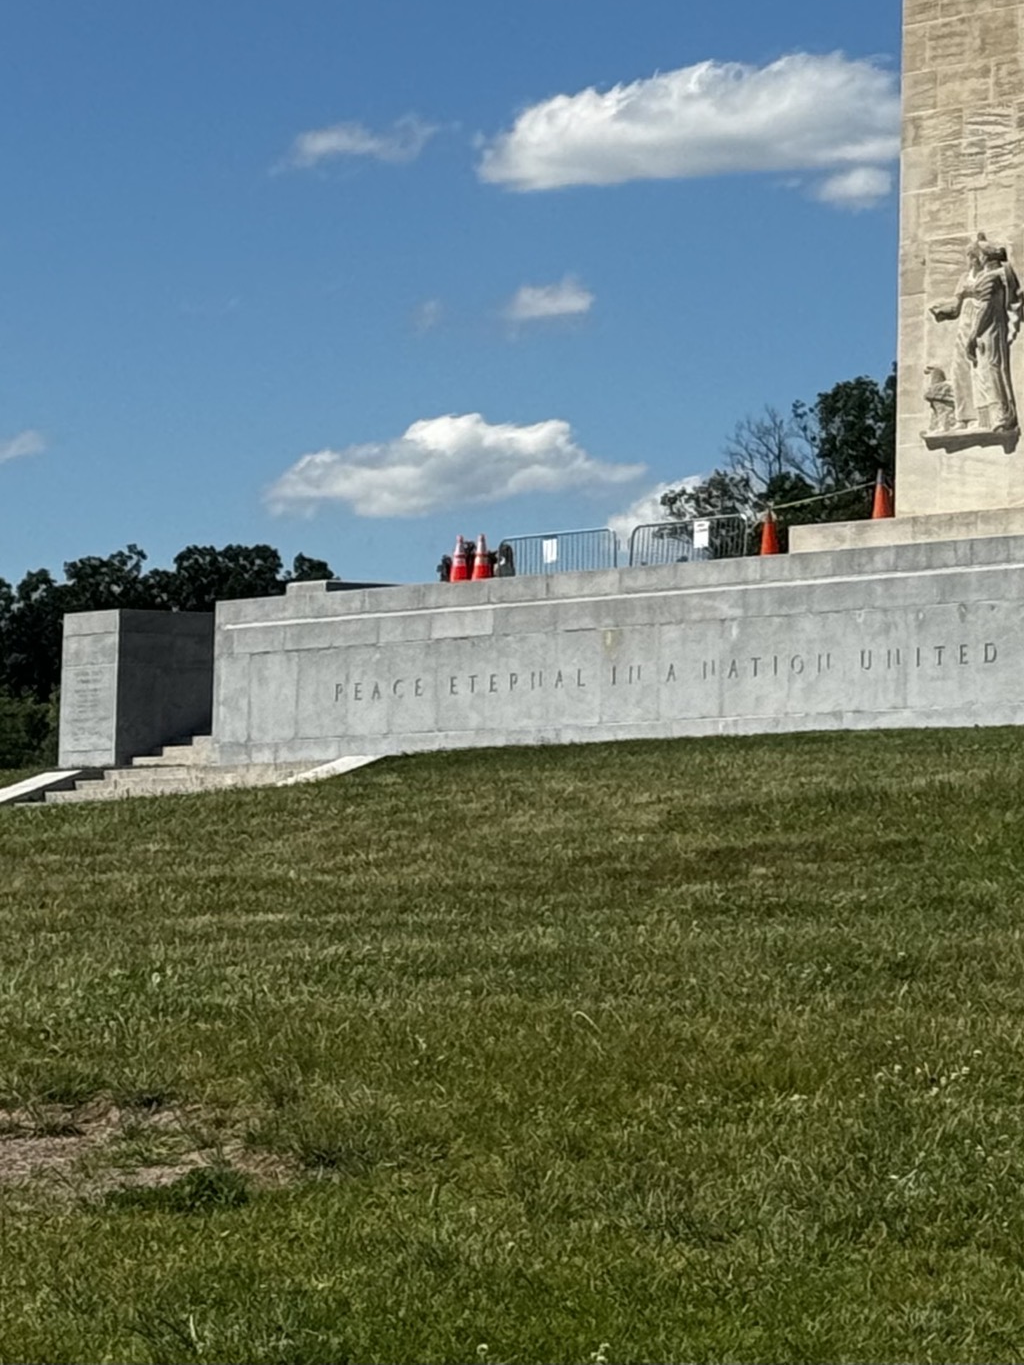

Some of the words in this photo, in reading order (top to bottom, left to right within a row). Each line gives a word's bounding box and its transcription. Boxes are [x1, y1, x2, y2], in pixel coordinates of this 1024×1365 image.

[334, 678, 424, 702] PEACE
[449, 668, 586, 695] ETERNAL
[611, 665, 642, 687] IN
[665, 663, 677, 682] A
[702, 652, 832, 681] NATION
[859, 642, 998, 671] UNITED
